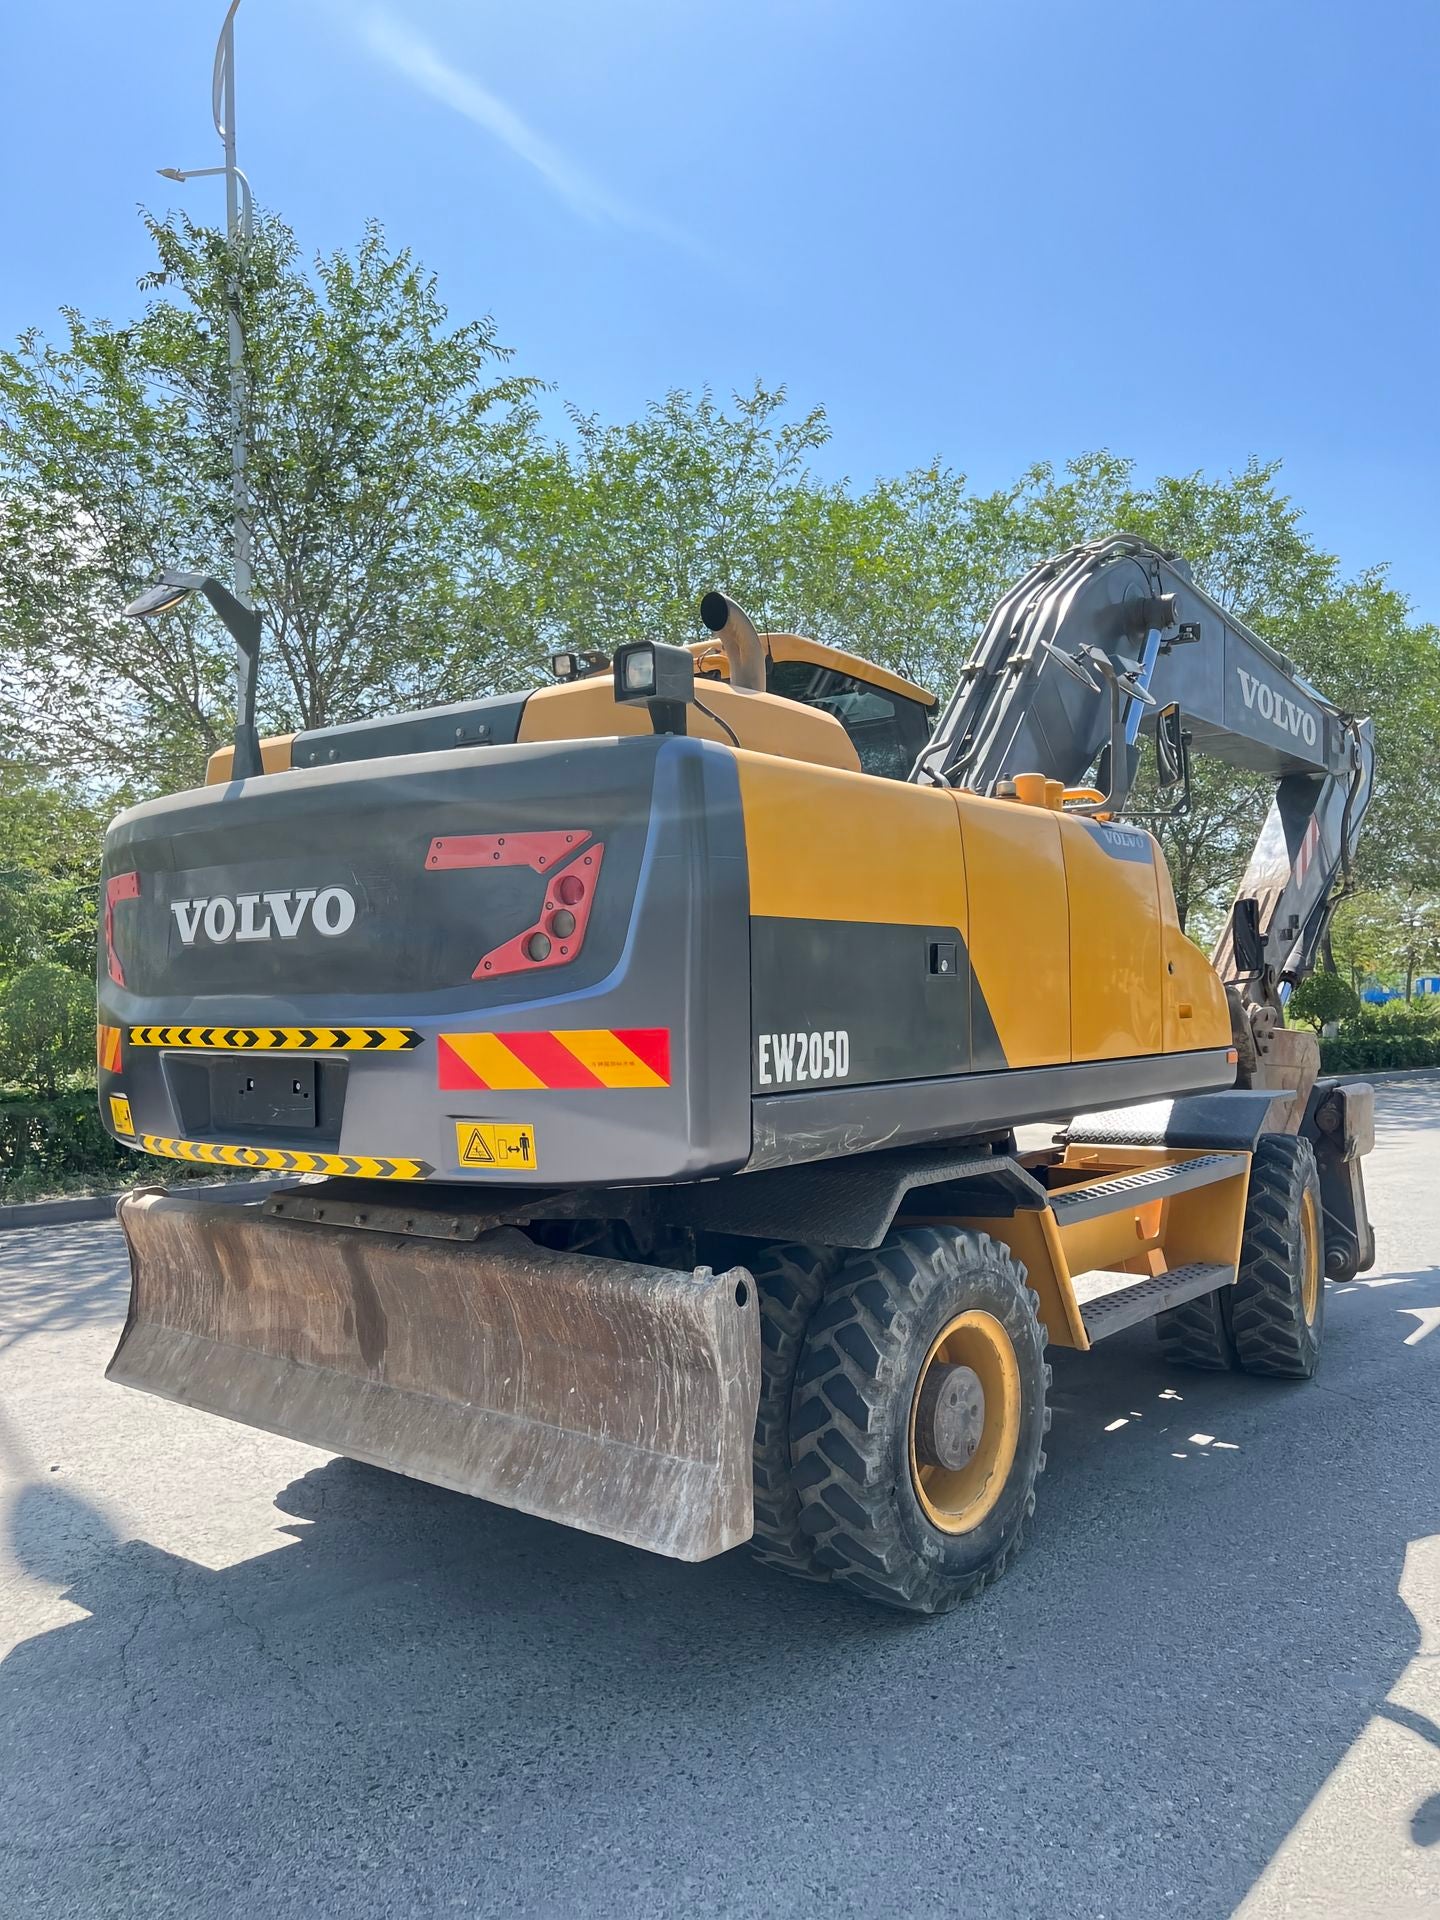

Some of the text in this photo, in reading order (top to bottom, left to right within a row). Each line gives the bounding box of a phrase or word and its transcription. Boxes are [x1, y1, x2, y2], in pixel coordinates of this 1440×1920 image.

[1237, 667, 1317, 746] VOLVO
[1103, 829, 1145, 848] VOLVO
[170, 886, 356, 944] VOLVO
[759, 1031, 849, 1085] EW205D
